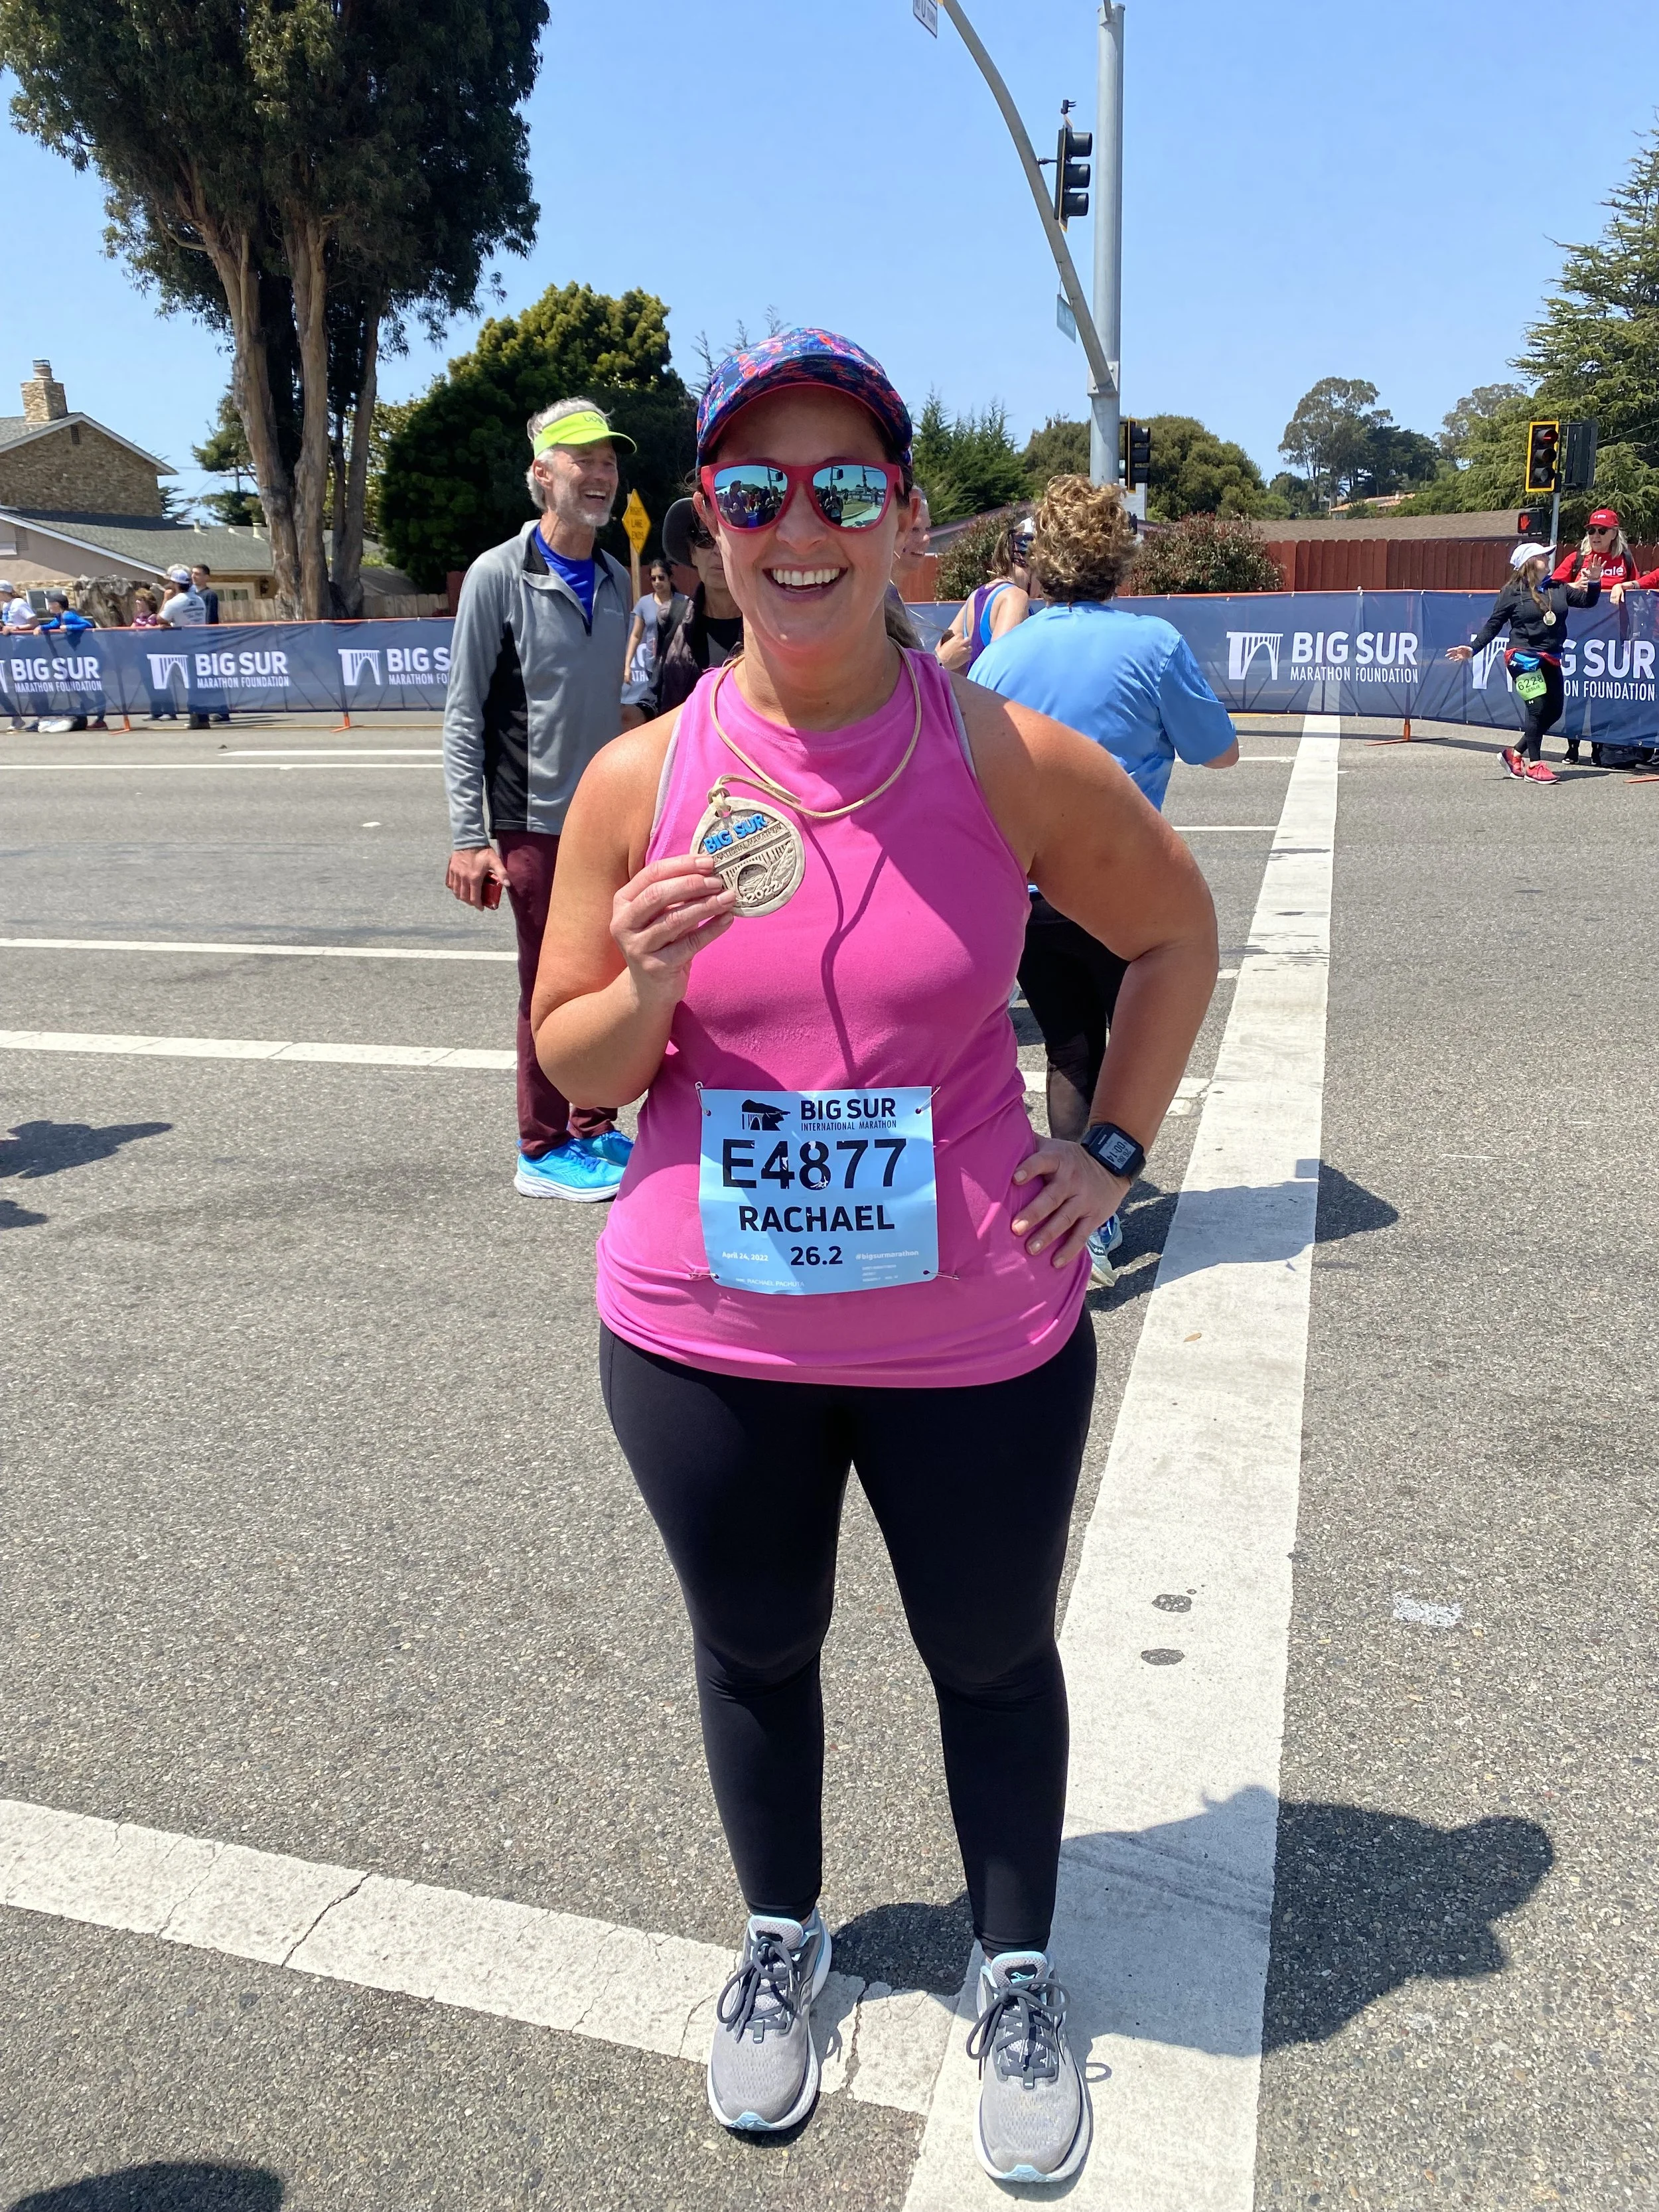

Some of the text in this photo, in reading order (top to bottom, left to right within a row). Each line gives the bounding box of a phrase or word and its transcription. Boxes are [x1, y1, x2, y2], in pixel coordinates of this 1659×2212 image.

[1291, 631, 1418, 665] BIG SUR
[11, 656, 100, 681] BIG SUR
[195, 651, 288, 676] BIG SUR
[387, 647, 429, 672] BIG
[1583, 639, 1656, 680] SUR
[197, 676, 289, 688] MARATHON FOUNDATION
[388, 673, 433, 685] MARATHON
[1290, 666, 1418, 684] MARATHON FOUNDATION
[1518, 674, 1544, 691] 6228
[15, 680, 102, 693] MARATHON FOUNDATION
[1583, 680, 1655, 701] FOUNDATION
[703, 813, 767, 854] BIG SUR
[747, 881, 781, 903] 2022
[801, 1098, 896, 1120] BIG SUR
[801, 1120, 897, 1132] INTERNATIONAL MARATHON
[722, 1138, 907, 1191] E4877
[739, 1205, 895, 1232] RACHAEL
[739, 1252, 750, 1261] 24,
[790, 1246, 843, 1266] 26.2
[855, 1250, 919, 1260] #bigsurmarathon
